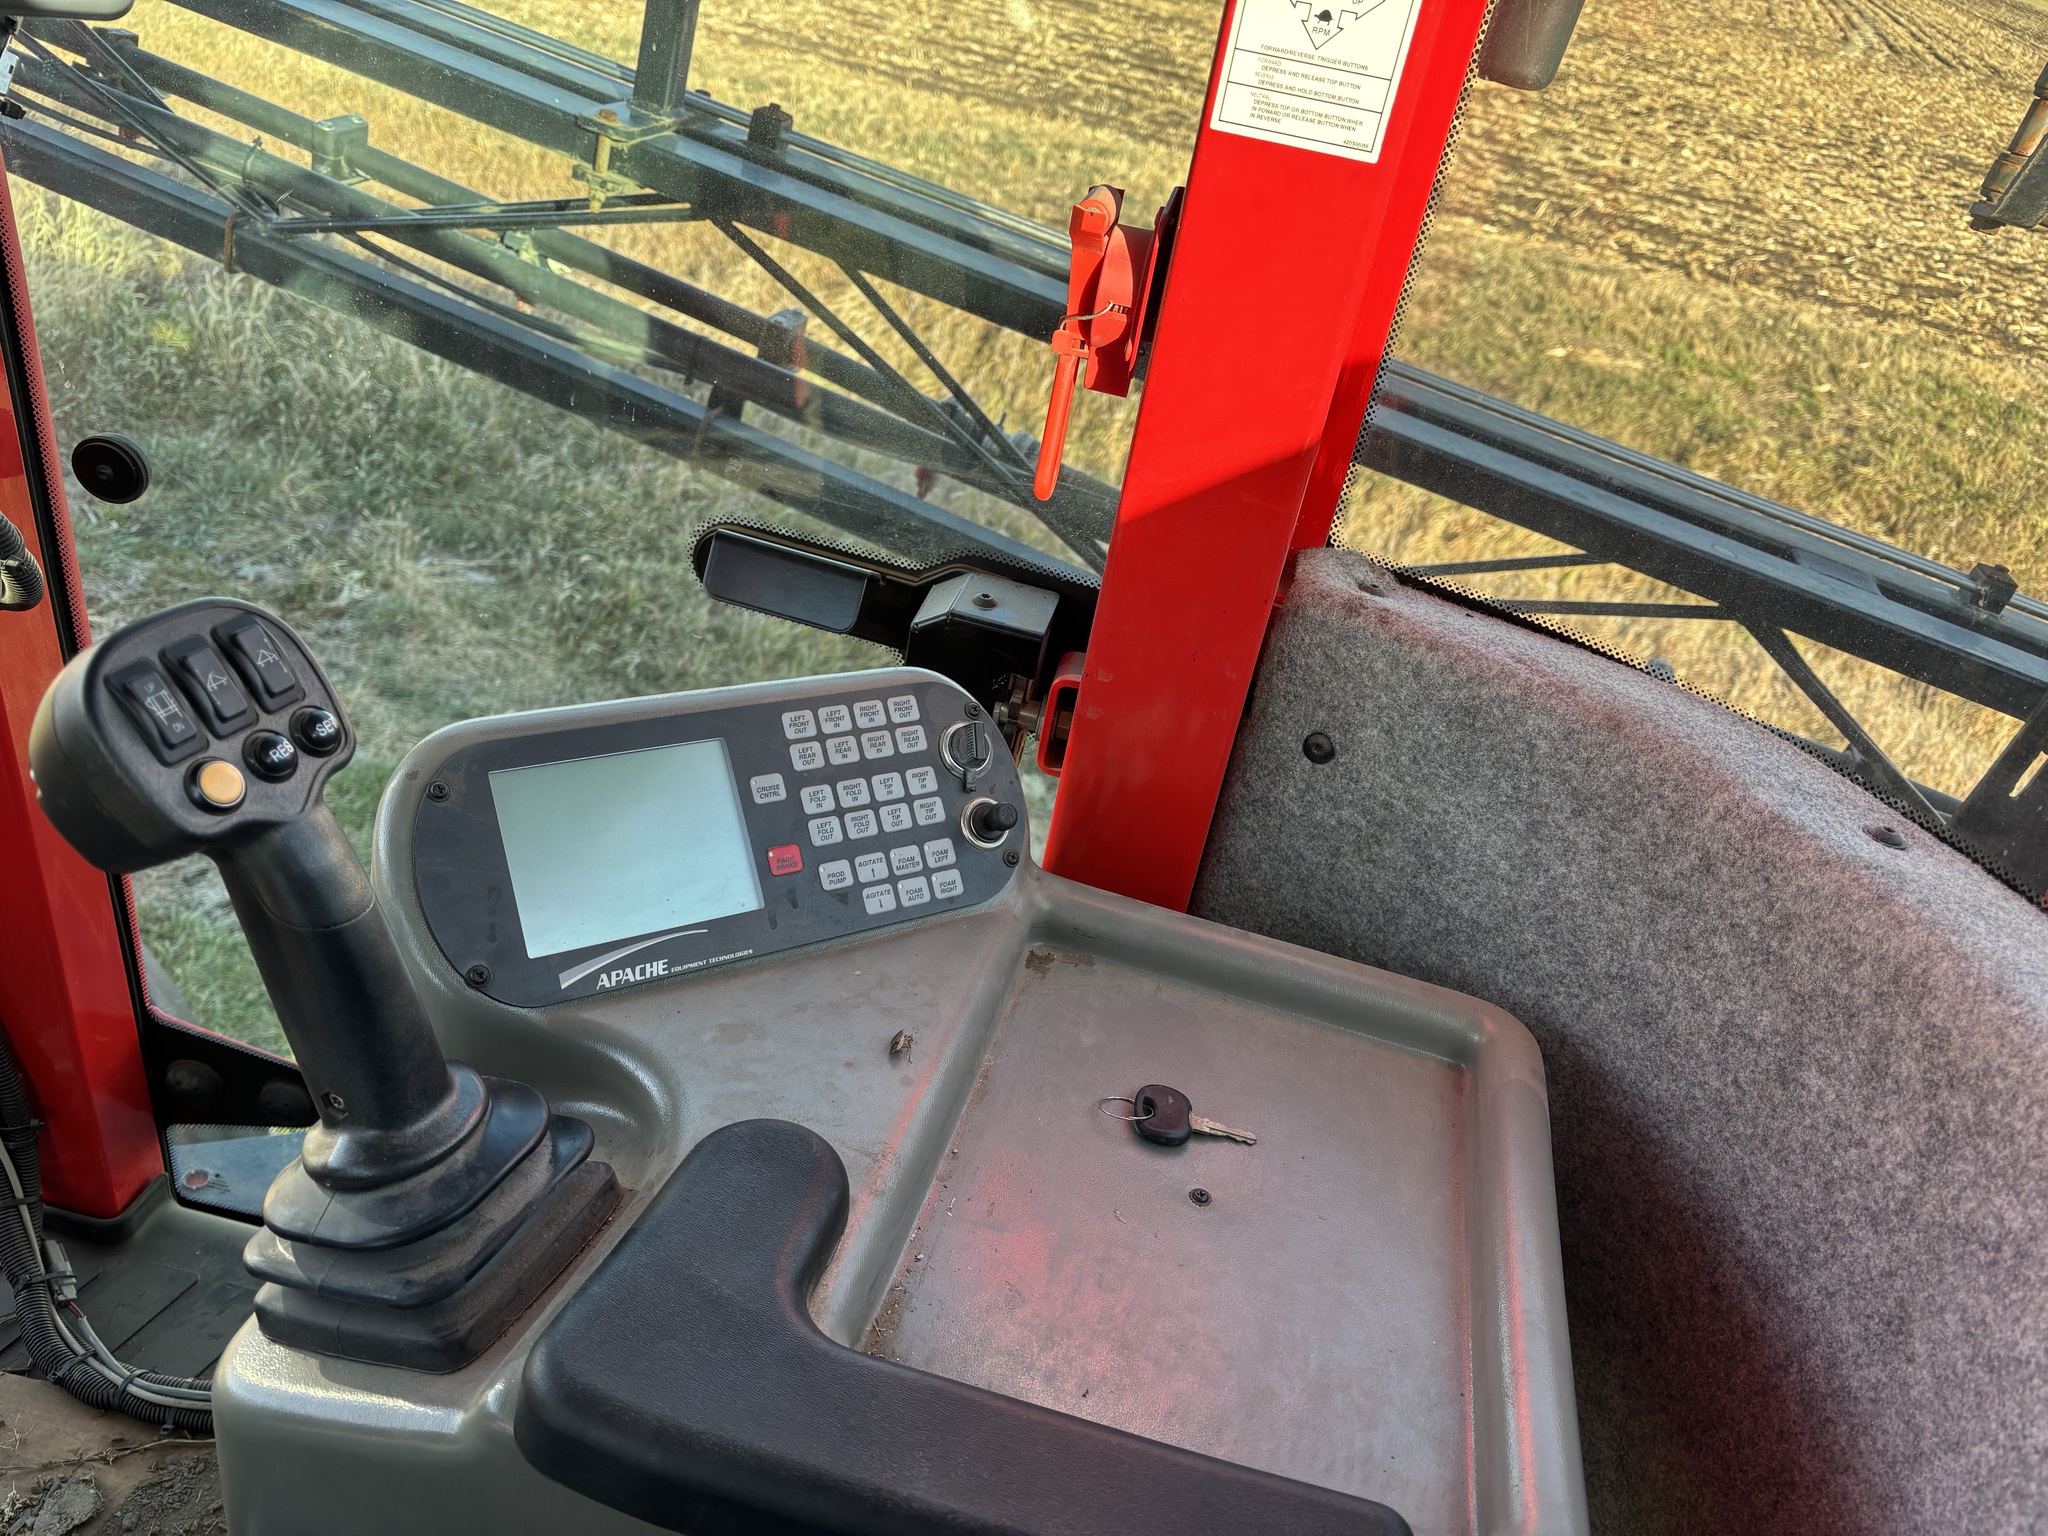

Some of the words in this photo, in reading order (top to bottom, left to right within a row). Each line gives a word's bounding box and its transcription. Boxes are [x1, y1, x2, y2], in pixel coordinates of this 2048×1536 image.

[1312, 26, 1331, 36] RPM
[1318, 56, 1342, 66] TRIGGER
[1342, 60, 1368, 71] BUTTONS
[1262, 65, 1286, 75] DEPRESS
[1301, 73, 1326, 83] RELEASE
[1339, 80, 1361, 90] BUTTON
[1258, 79, 1283, 89] DEPRESS
[1298, 87, 1312, 95] HOLD
[1314, 90, 1336, 99] BOTTOM
[1337, 96, 1359, 105] BUTTON
[1254, 99, 1278, 109] DEPRESS
[1301, 108, 1324, 118] BOTTOM
[1324, 113, 1346, 123] BUTTON
[1346, 118, 1364, 126] WHEN
[1256, 114, 1282, 124] REVERSE
[1258, 107, 1281, 116] FOWARD
[1291, 114, 1316, 124] RELEASE
[1317, 119, 1339, 128] BUTTON
[1340, 124, 1356, 132] WHEN
[789, 721, 810, 729] FRONT
[798, 746, 813, 754] LEFT
[802, 758, 815, 766] OUT
[912, 771, 929, 779] RIGHT
[756, 784, 781, 793] CRUISE
[843, 783, 861, 791] RIGHT
[759, 791, 781, 800] CNTRL
[809, 789, 824, 797] LEFT
[845, 789, 862, 797] FOLD
[810, 795, 826, 803] FOLD
[919, 802, 937, 810] RIGHT
[887, 808, 901, 816] LEFT
[850, 814, 869, 822] RIGHT
[816, 821, 831, 829] LEFT
[853, 820, 870, 828] FOLD
[817, 827, 834, 835] FOLD
[932, 849, 948, 858] FOAM
[776, 856, 794, 864] PARK
[858, 857, 884, 868] AGITATE
[898, 856, 915, 865] FOAM
[934, 854, 948, 863] LEFT
[776, 862, 798, 871] BRAKE
[896, 861, 920, 871] MASTER
[828, 871, 846, 880] PROD.
[829, 877, 847, 886] PUMP
[940, 880, 956, 888] FOAM
[866, 889, 891, 899] AGITATE
[906, 887, 923, 896] FOAM
[940, 886, 958, 894] RIGHT
[908, 893, 924, 902] AUTO
[596, 959, 668, 990] APACHE
[671, 960, 707, 972] EQUIPMENT
[709, 949, 753, 964] TECHNOLOGIES
